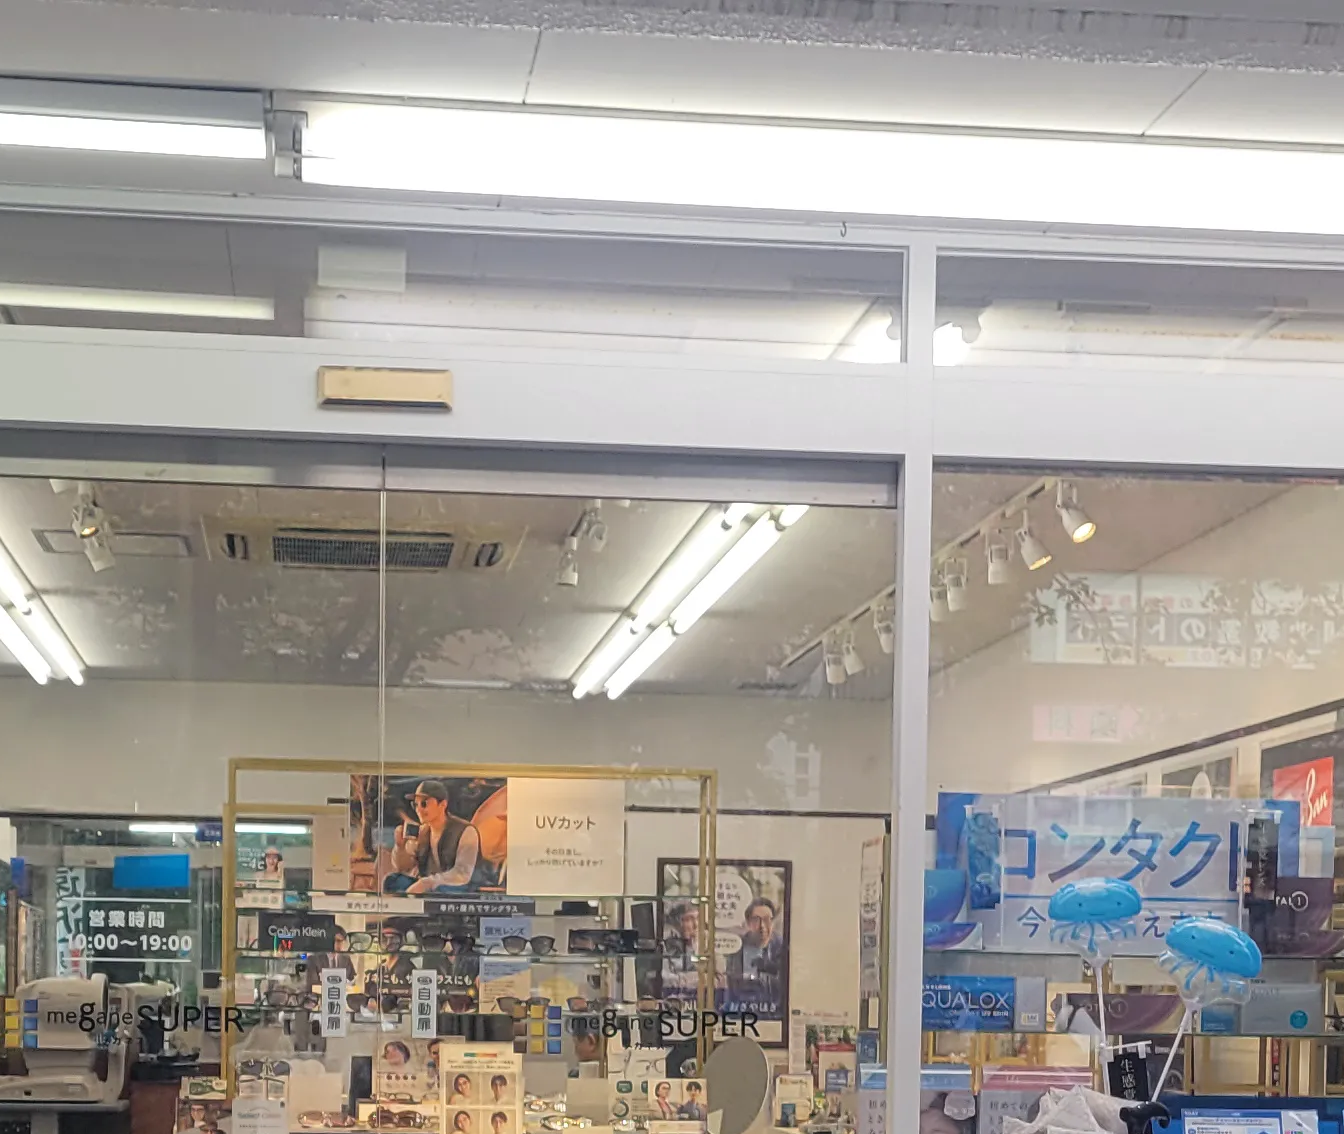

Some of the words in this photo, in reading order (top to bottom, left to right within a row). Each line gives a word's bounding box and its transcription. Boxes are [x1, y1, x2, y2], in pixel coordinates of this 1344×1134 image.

[535, 815, 596, 831] UVカット
[88, 909, 166, 928] 営業時間
[268, 925, 301, 937] Calvin
[302, 926, 326, 938] Klein
[922, 991, 1010, 1010] QUALOX
[137, 1003, 245, 1034] SUPER
[659, 1010, 761, 1038] SUPER
